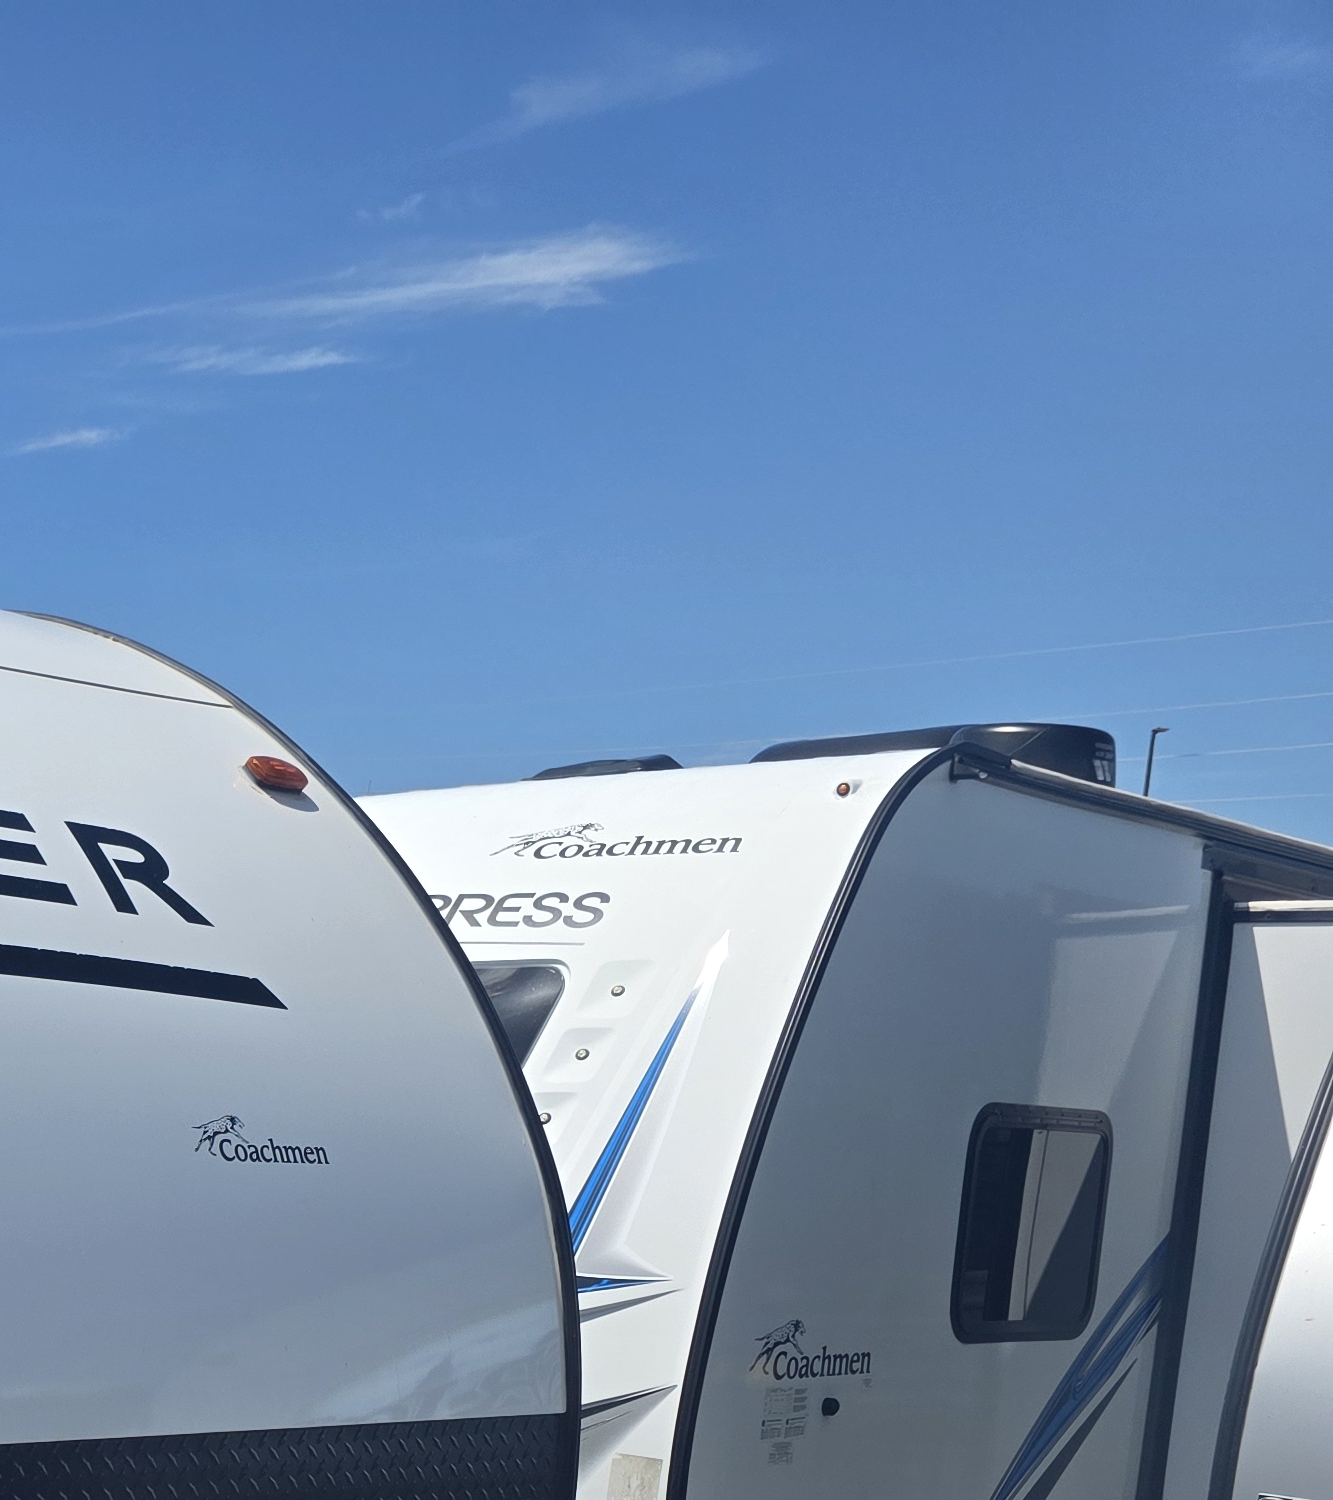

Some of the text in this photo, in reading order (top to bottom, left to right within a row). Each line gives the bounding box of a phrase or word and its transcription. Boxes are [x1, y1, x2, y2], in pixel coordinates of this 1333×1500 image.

[533, 835, 743, 860] Coachmen
[219, 1138, 331, 1165] Coachmen
[772, 1345, 872, 1381] Coachmen
